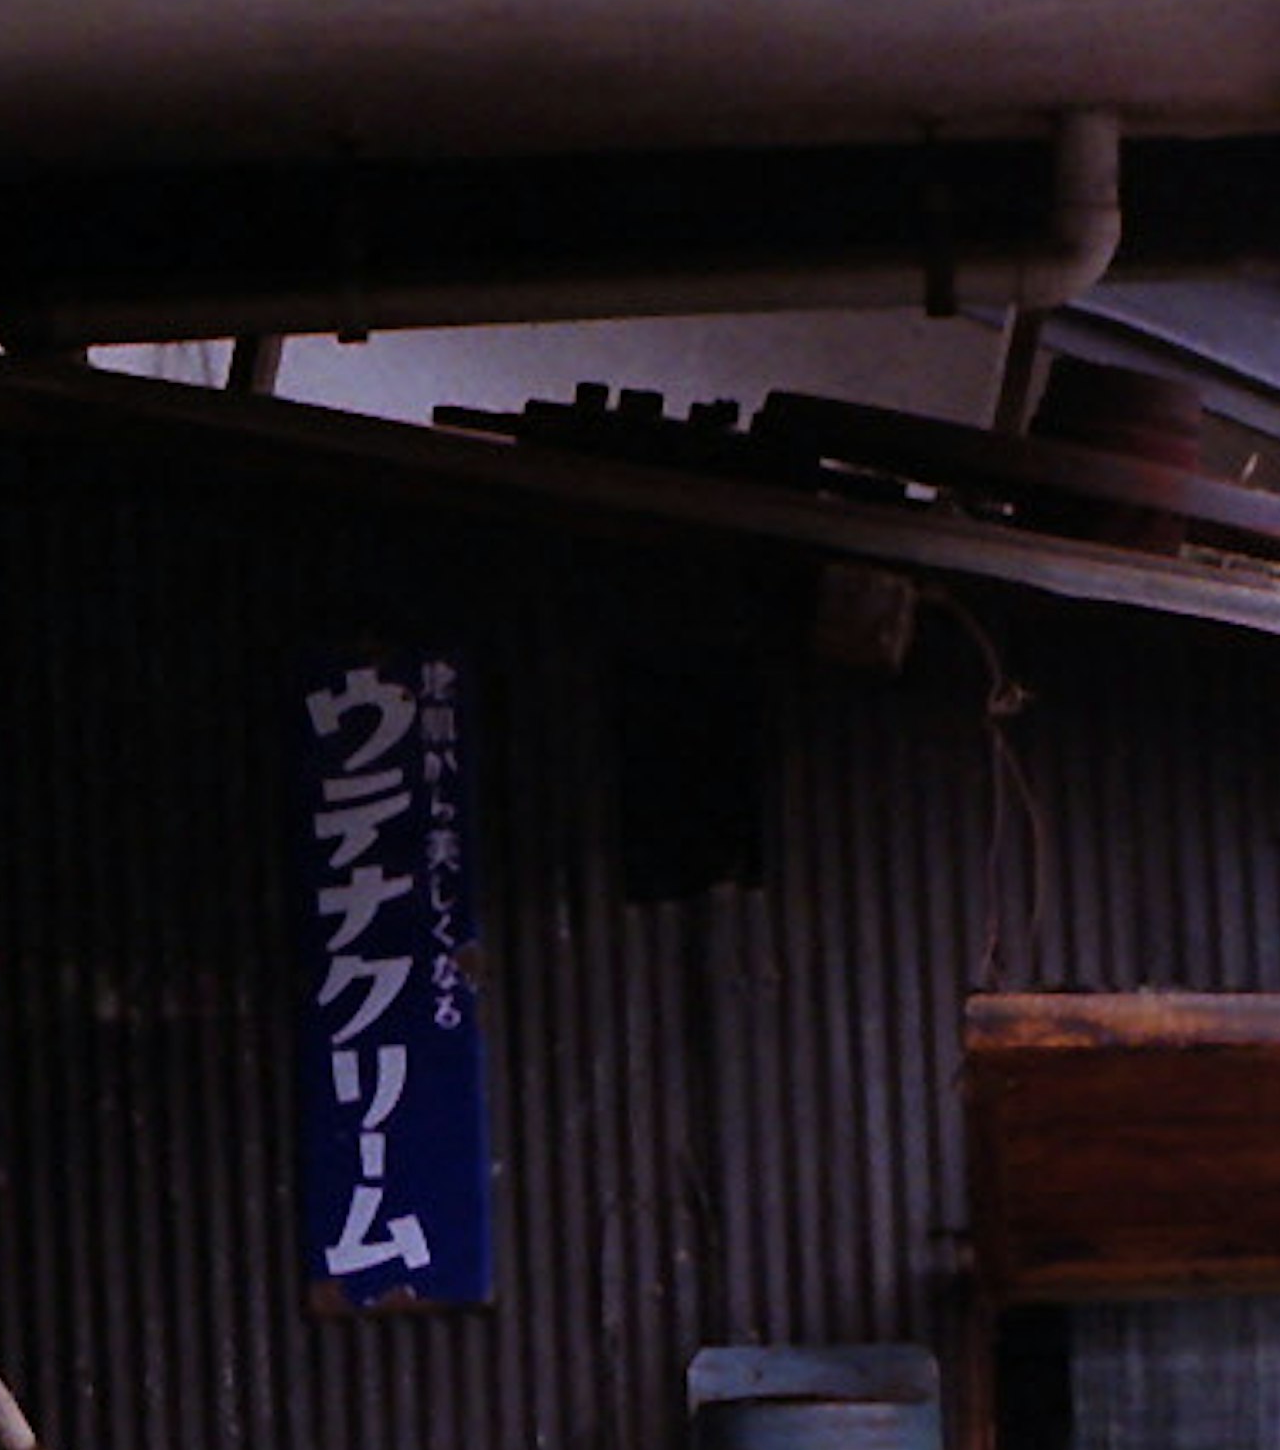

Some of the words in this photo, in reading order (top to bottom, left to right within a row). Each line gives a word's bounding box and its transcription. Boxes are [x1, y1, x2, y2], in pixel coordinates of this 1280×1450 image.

[306, 668, 430, 1275] ウテナクリーム
